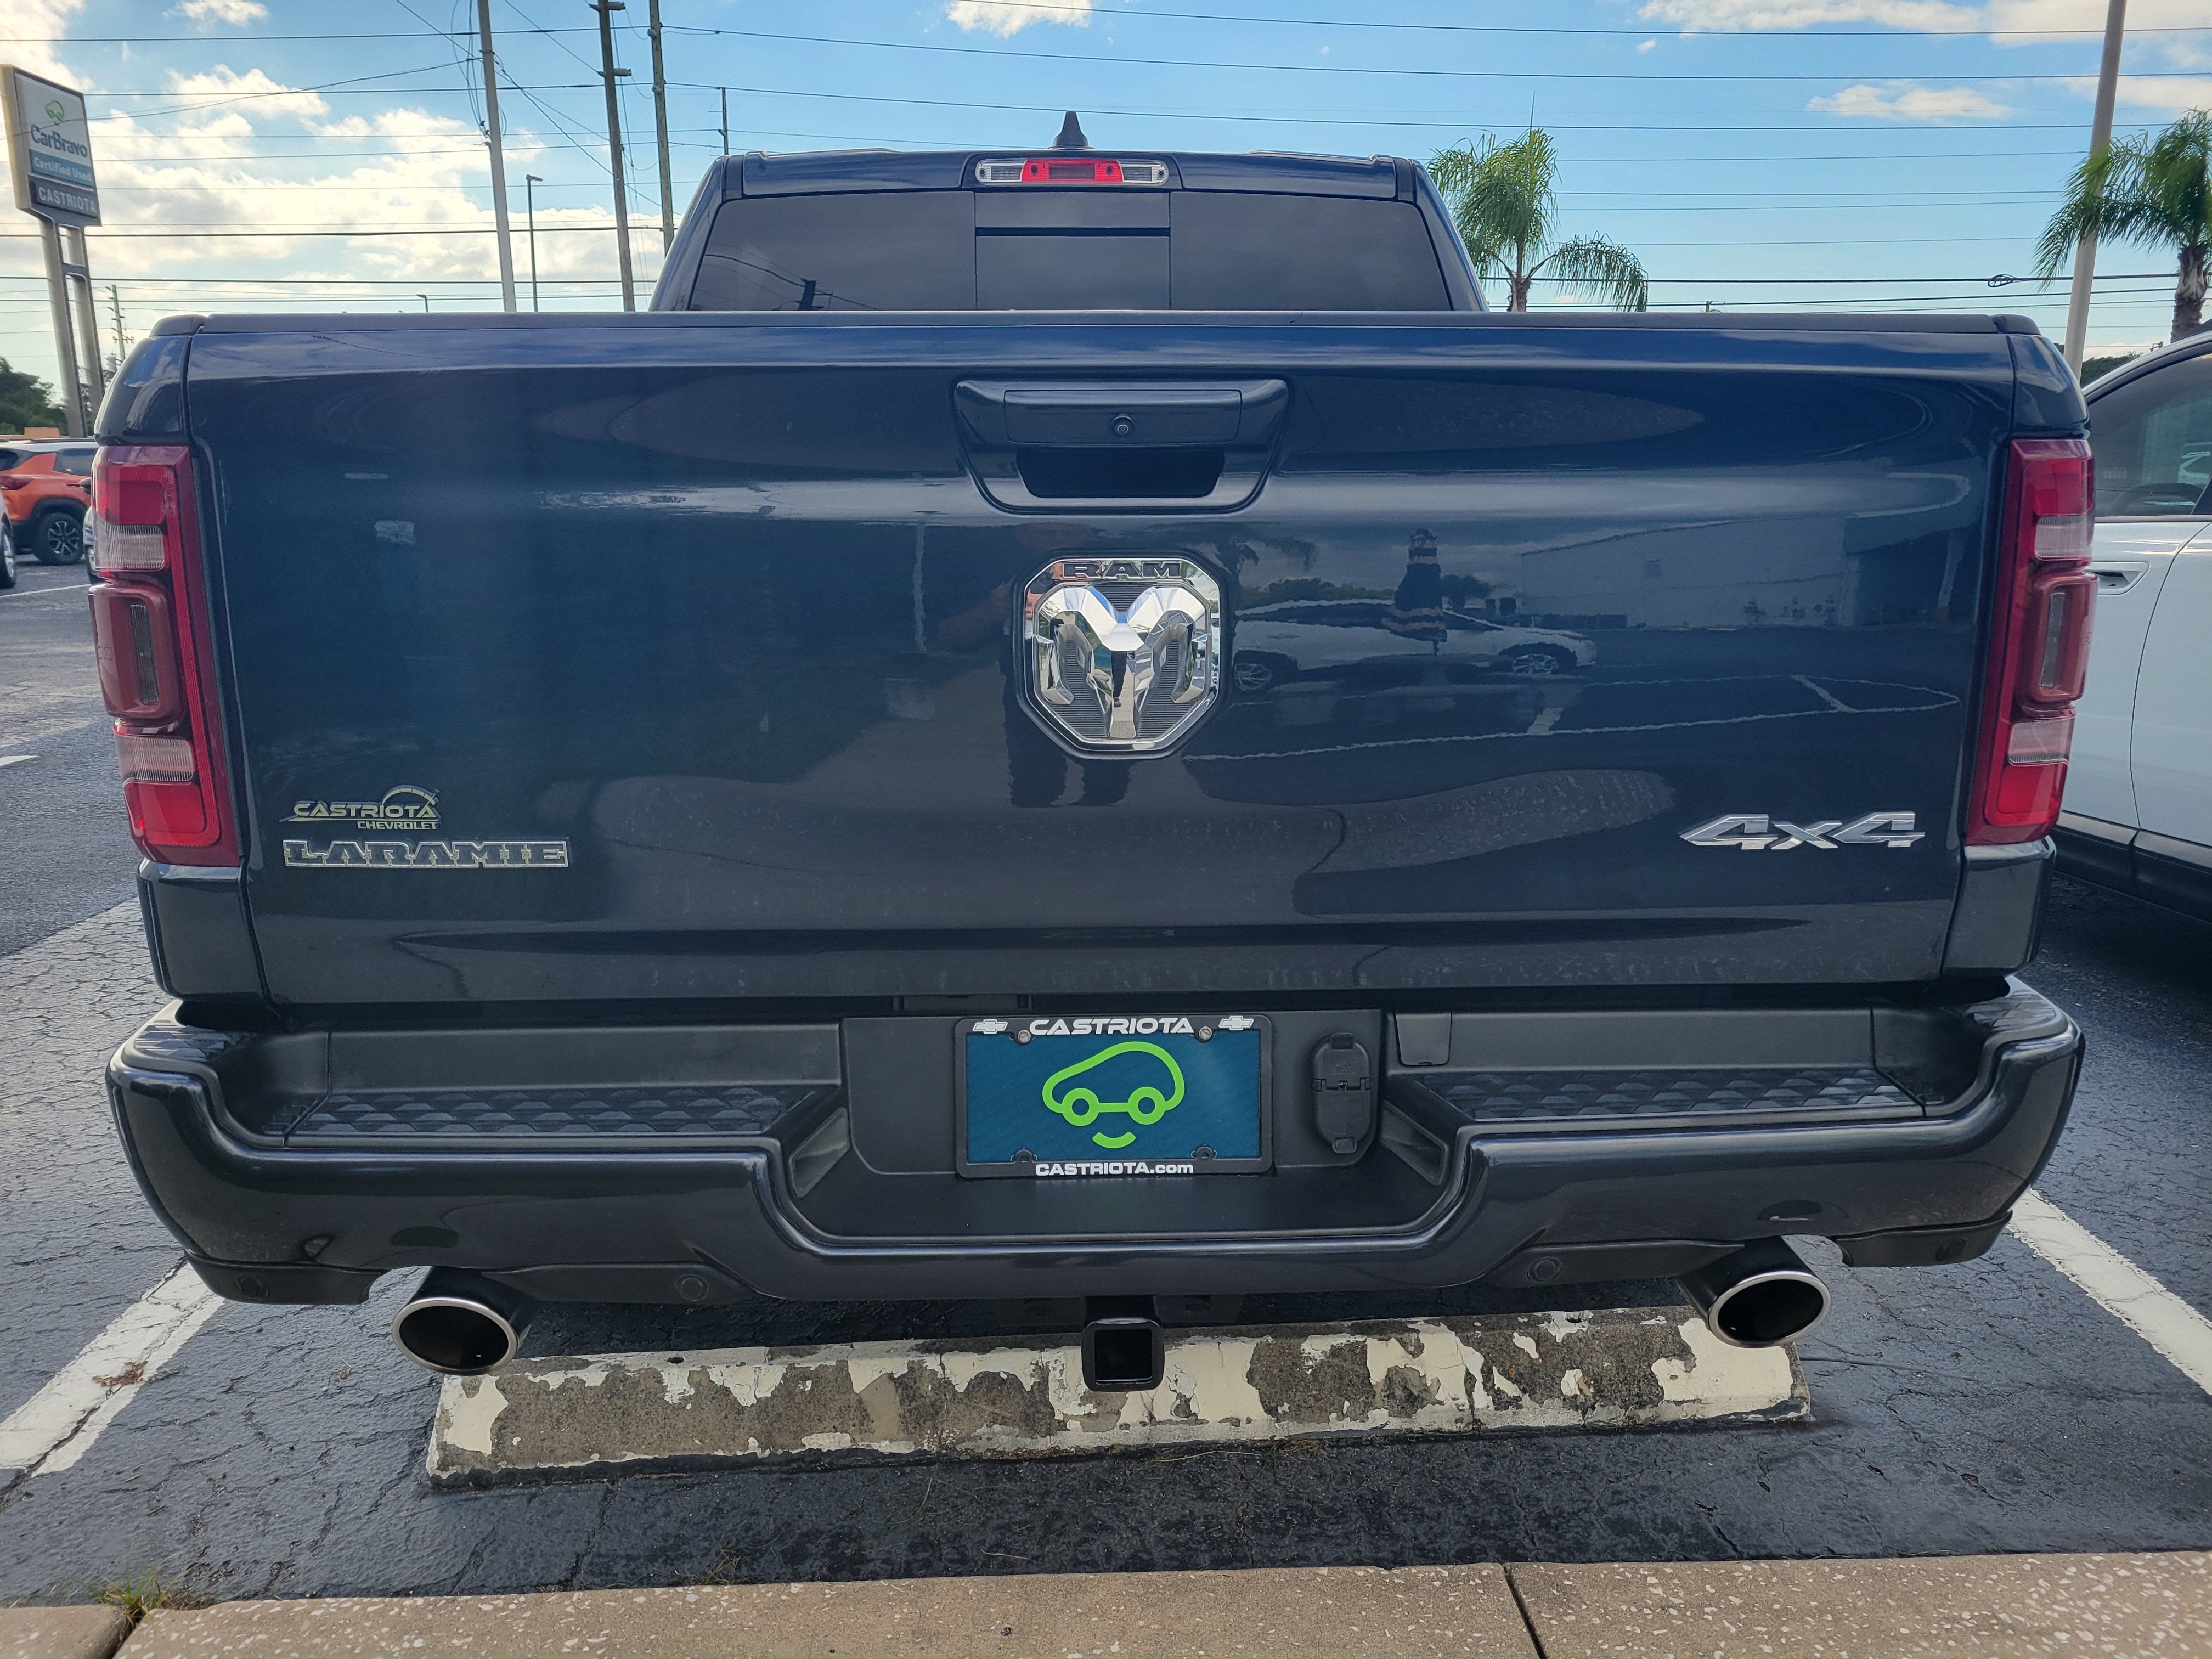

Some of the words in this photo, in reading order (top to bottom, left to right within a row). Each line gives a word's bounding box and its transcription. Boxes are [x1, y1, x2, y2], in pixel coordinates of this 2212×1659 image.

[31, 124, 88, 157] CarBravo
[35, 156, 71, 175] Certified
[72, 168, 92, 182] Used
[38, 186, 97, 213] CASTRIOTA
[1063, 562, 1182, 579] RAM
[294, 803, 438, 818] CASTRIOTA
[357, 821, 438, 830] CHEVROLET
[1679, 811, 1926, 850] 4x4
[283, 840, 568, 867] LARAMIE
[1029, 1017, 1194, 1035] CASTRIOTA
[1035, 1162, 1194, 1177] CASTRIOTA.com
